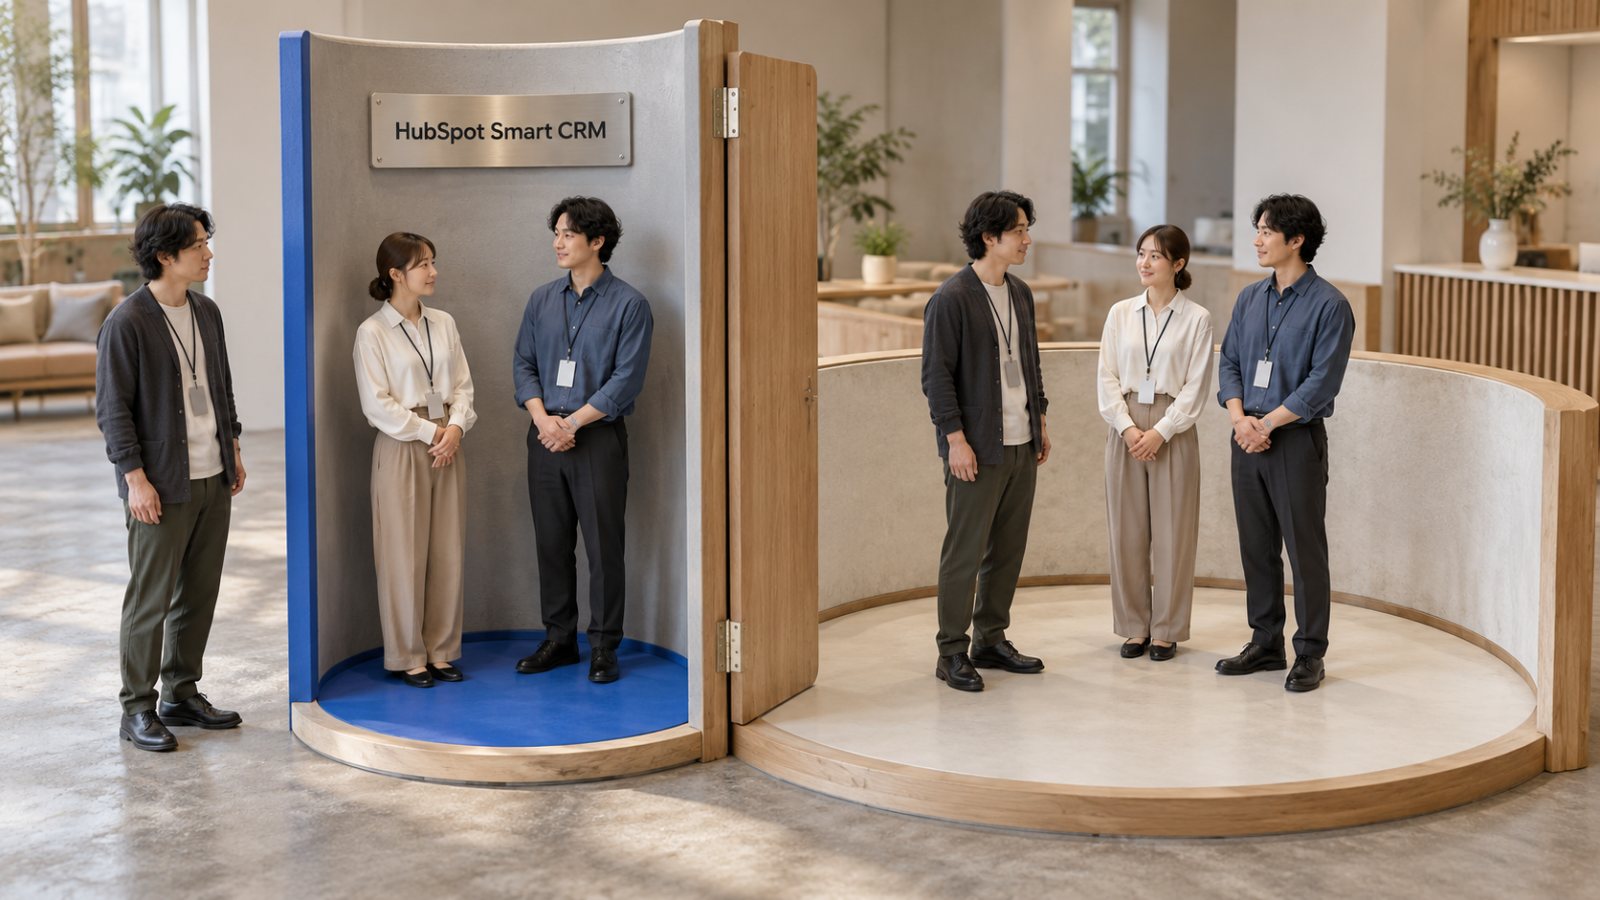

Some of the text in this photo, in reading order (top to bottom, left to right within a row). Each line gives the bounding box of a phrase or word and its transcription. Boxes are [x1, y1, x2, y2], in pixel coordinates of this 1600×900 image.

[395, 120, 606, 144] HubSpot Smart CRM
